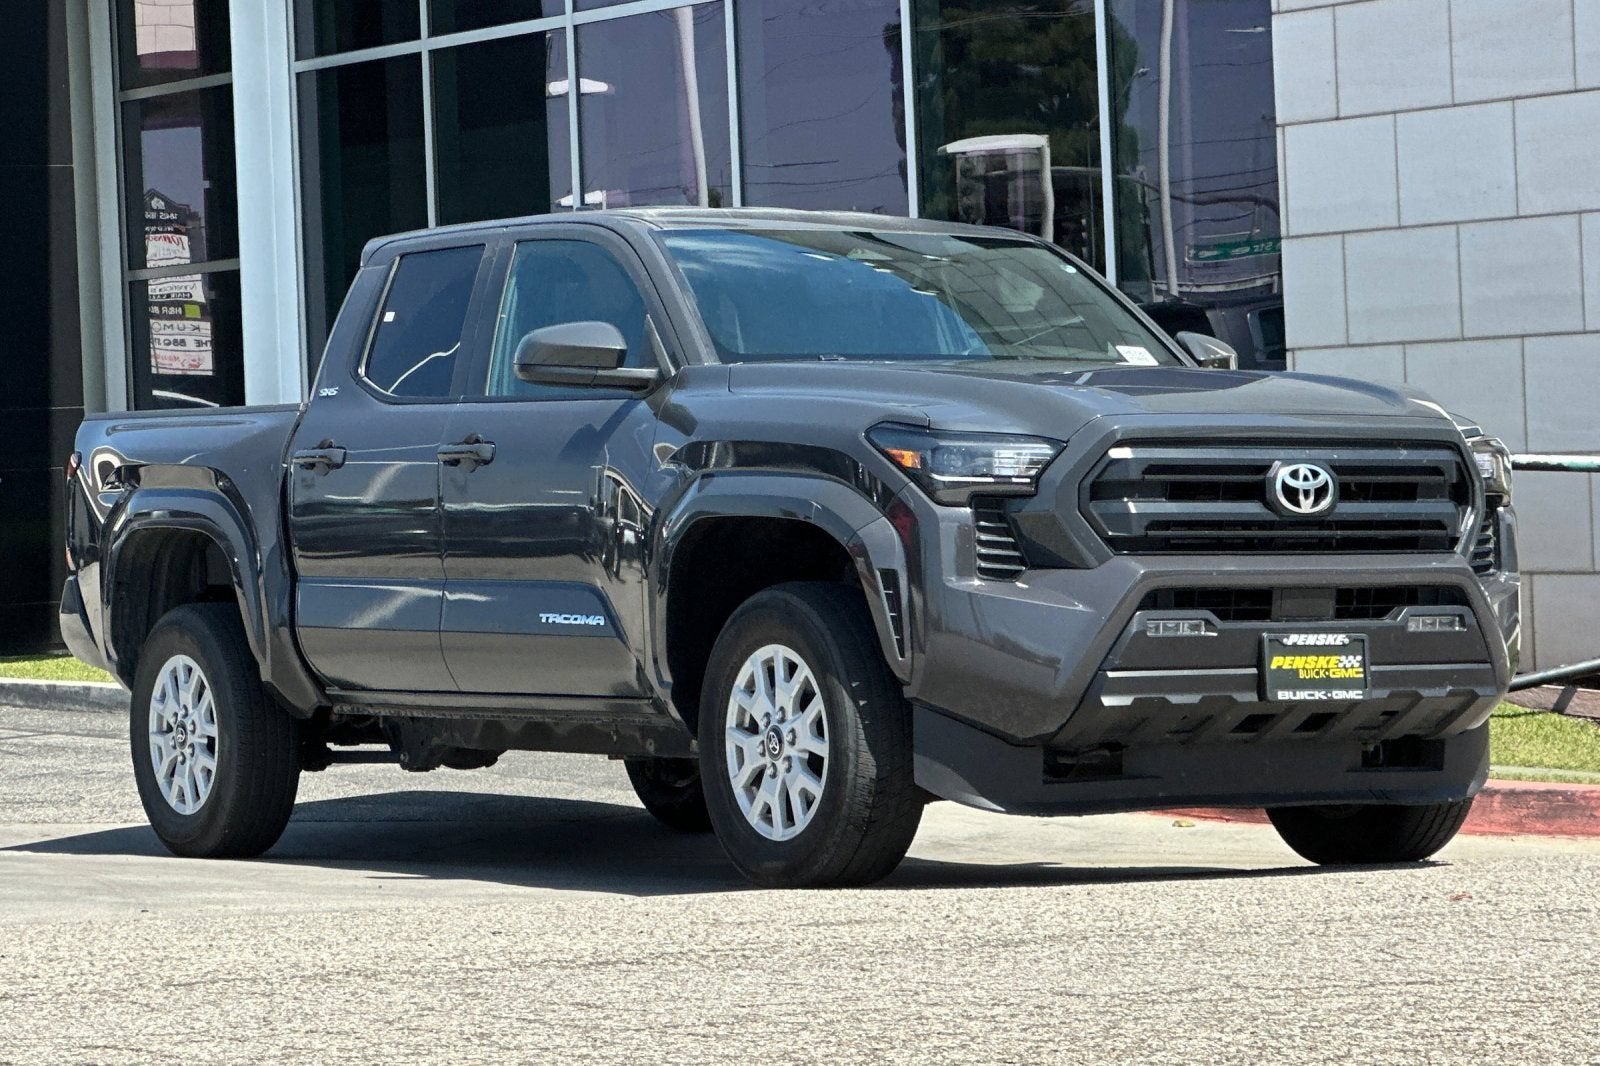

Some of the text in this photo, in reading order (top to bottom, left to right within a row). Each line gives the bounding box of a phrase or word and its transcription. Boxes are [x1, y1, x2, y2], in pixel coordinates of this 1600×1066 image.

[539, 613, 605, 626] TACOMA
[1287, 633, 1346, 646] PENSKE
[1270, 655, 1340, 669] PENSKE
